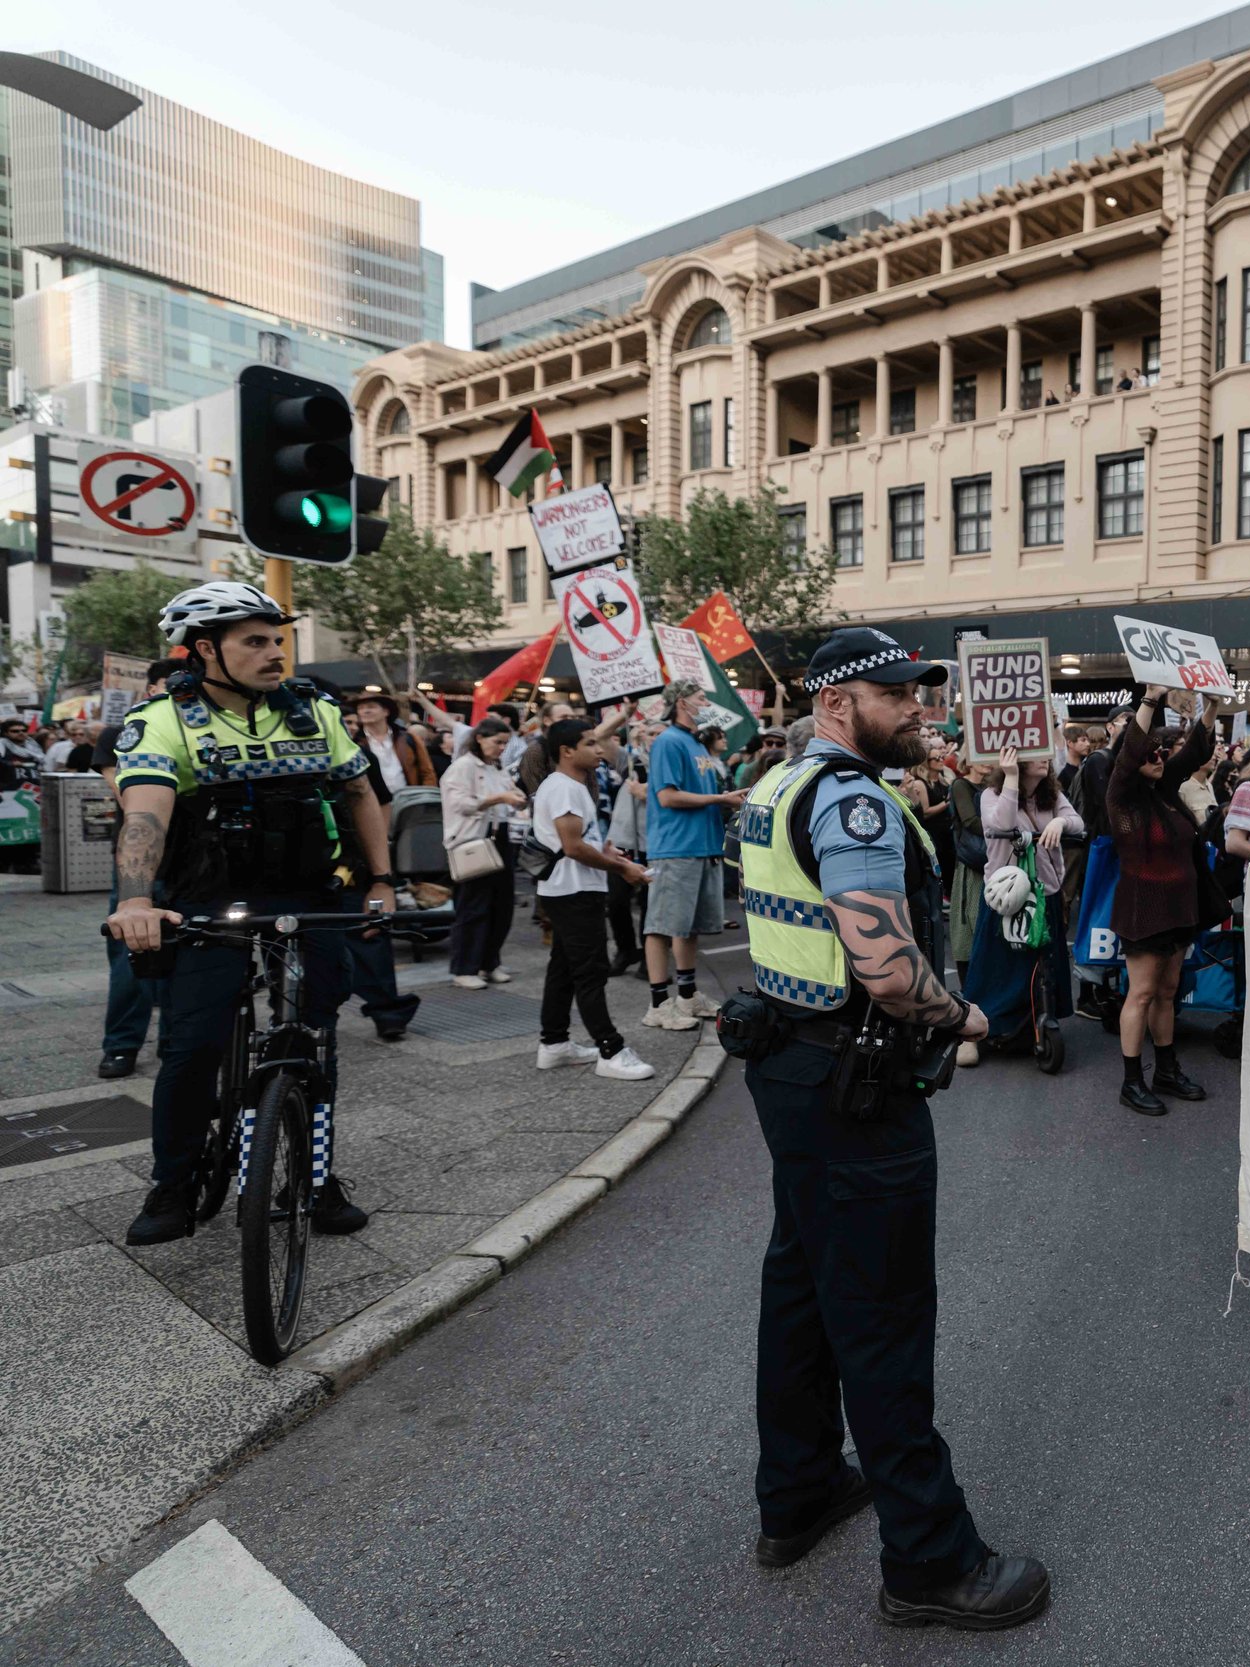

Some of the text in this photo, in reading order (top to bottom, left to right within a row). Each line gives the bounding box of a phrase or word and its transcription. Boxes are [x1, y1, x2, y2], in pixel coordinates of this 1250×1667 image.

[563, 519, 588, 540] NOT
[970, 655, 1041, 677] FUND
[1178, 659, 1232, 690] DEATH
[972, 675, 1042, 701] NDIS
[981, 705, 1038, 728] NOT
[276, 741, 325, 753] POLICE
[981, 727, 1041, 751] WAR
